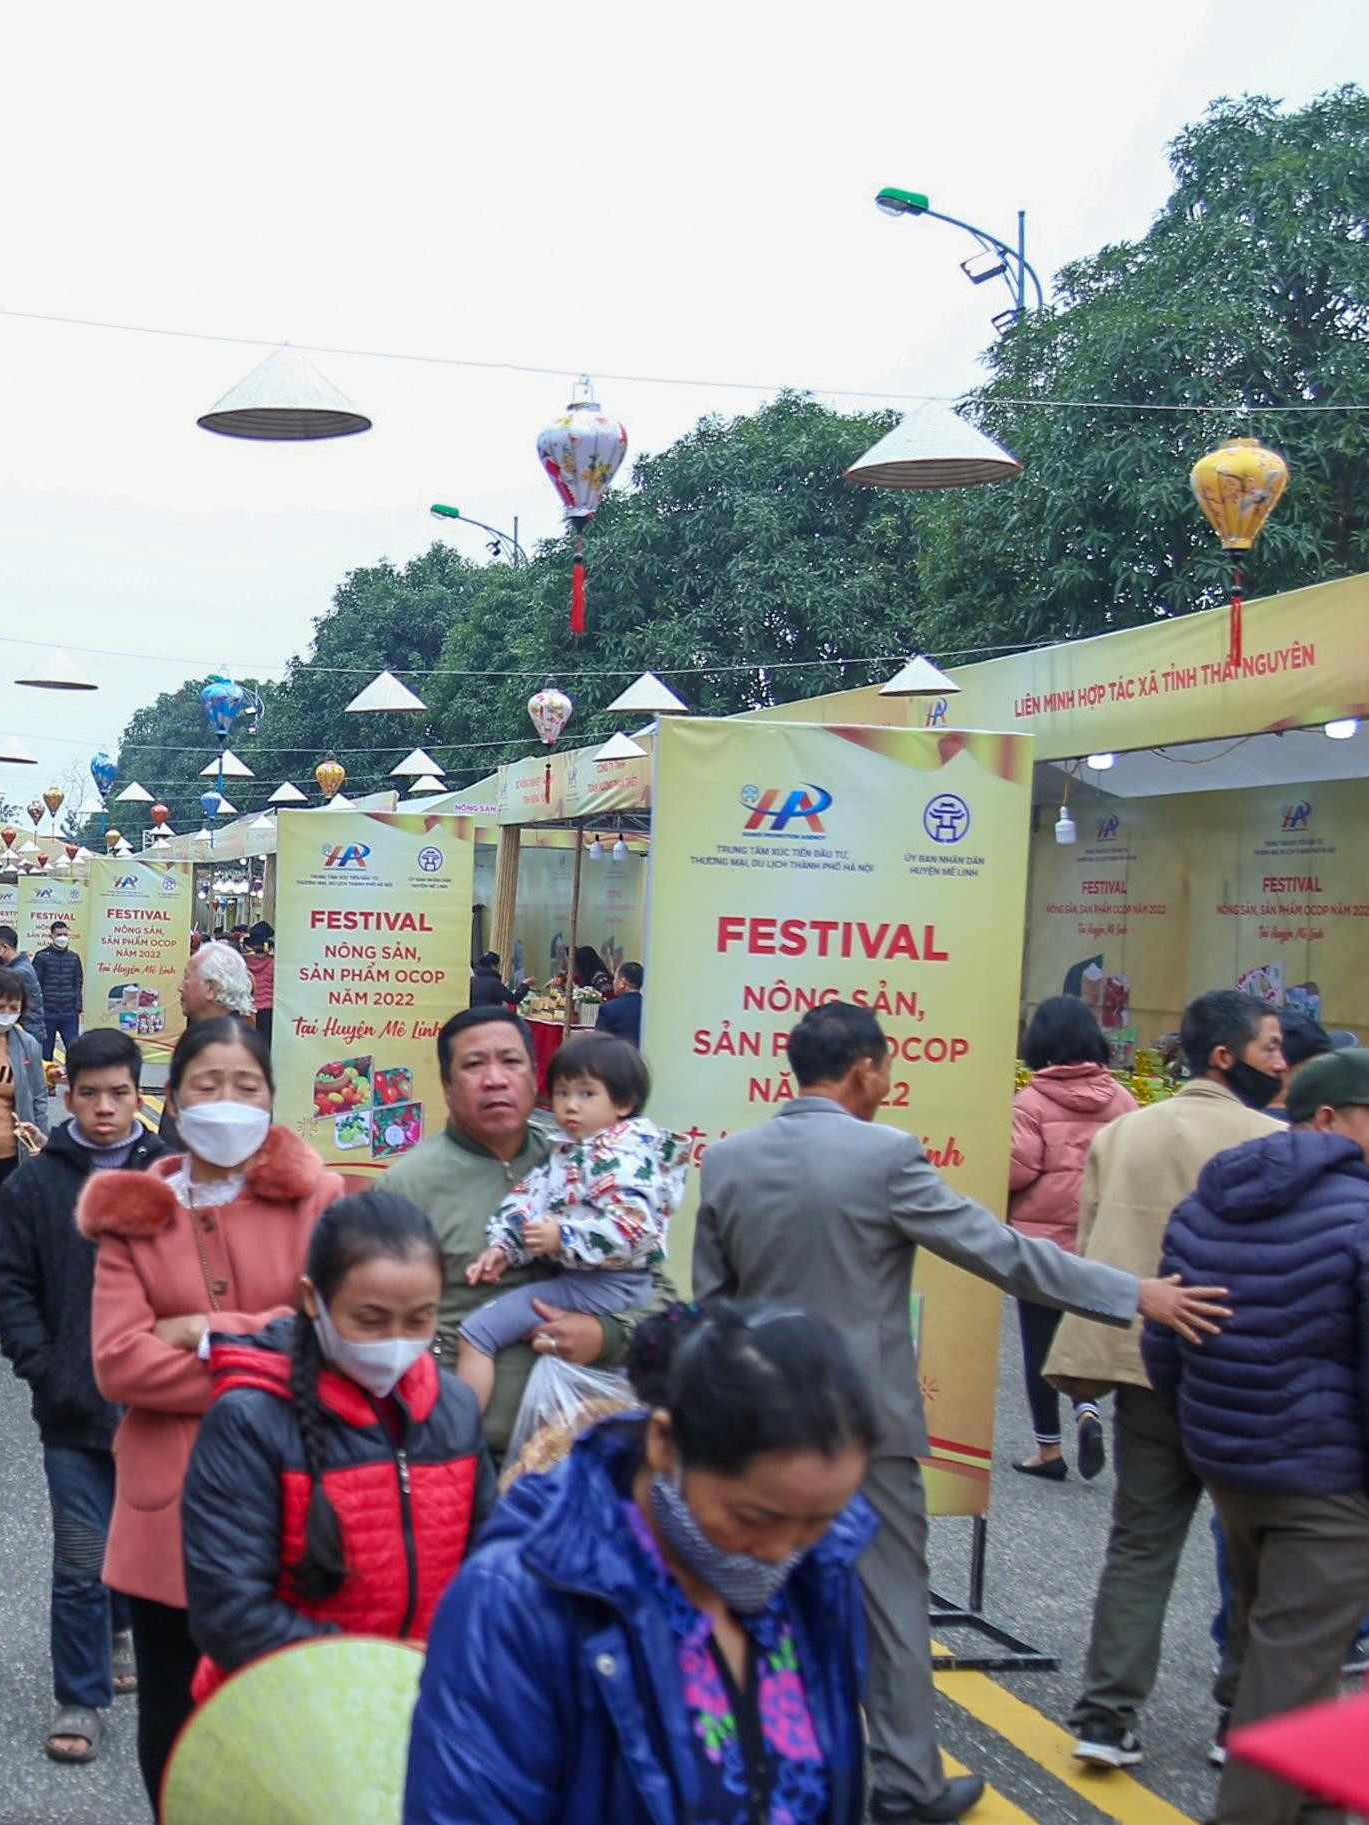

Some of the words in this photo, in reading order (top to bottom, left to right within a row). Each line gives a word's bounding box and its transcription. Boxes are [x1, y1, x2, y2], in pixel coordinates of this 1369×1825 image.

[1015, 693, 1042, 718] LIÊN
[1043, 690, 1075, 713] MINH
[1077, 683, 1106, 712] HỢP
[1108, 675, 1135, 702] TÁC
[1138, 672, 1160, 698] XÃ
[1161, 662, 1198, 693] TỈNH
[1243, 640, 1316, 679] NGUYÊN
[752, 859, 765, 868] DU
[1081, 880, 1128, 895] FESTIVAL
[1262, 876, 1324, 894] FESTIVAL
[30, 911, 77, 921] FESTIVAL
[107, 908, 171, 921] FESTIVAL
[310, 910, 434, 932] FESTIVAL
[114, 924, 142, 934] NÔNG
[716, 915, 950, 962] FESTIVAL
[150, 940, 177, 948] OCOP
[324, 943, 377, 962] NÔNG
[381, 942, 423, 963] SẢN,
[139, 950, 161, 959] 2022
[299, 963, 335, 982] SẢN
[340, 962, 391, 984] PHẨM
[395, 968, 446, 985] OCOP
[328, 988, 369, 1006] NĂM
[373, 991, 415, 1007] 2022
[851, 980, 925, 1021] SẢN,
[321, 1016, 376, 1045] Huyện
[377, 1019, 408, 1039] Mê
[693, 1019, 762, 1058] SẢN
